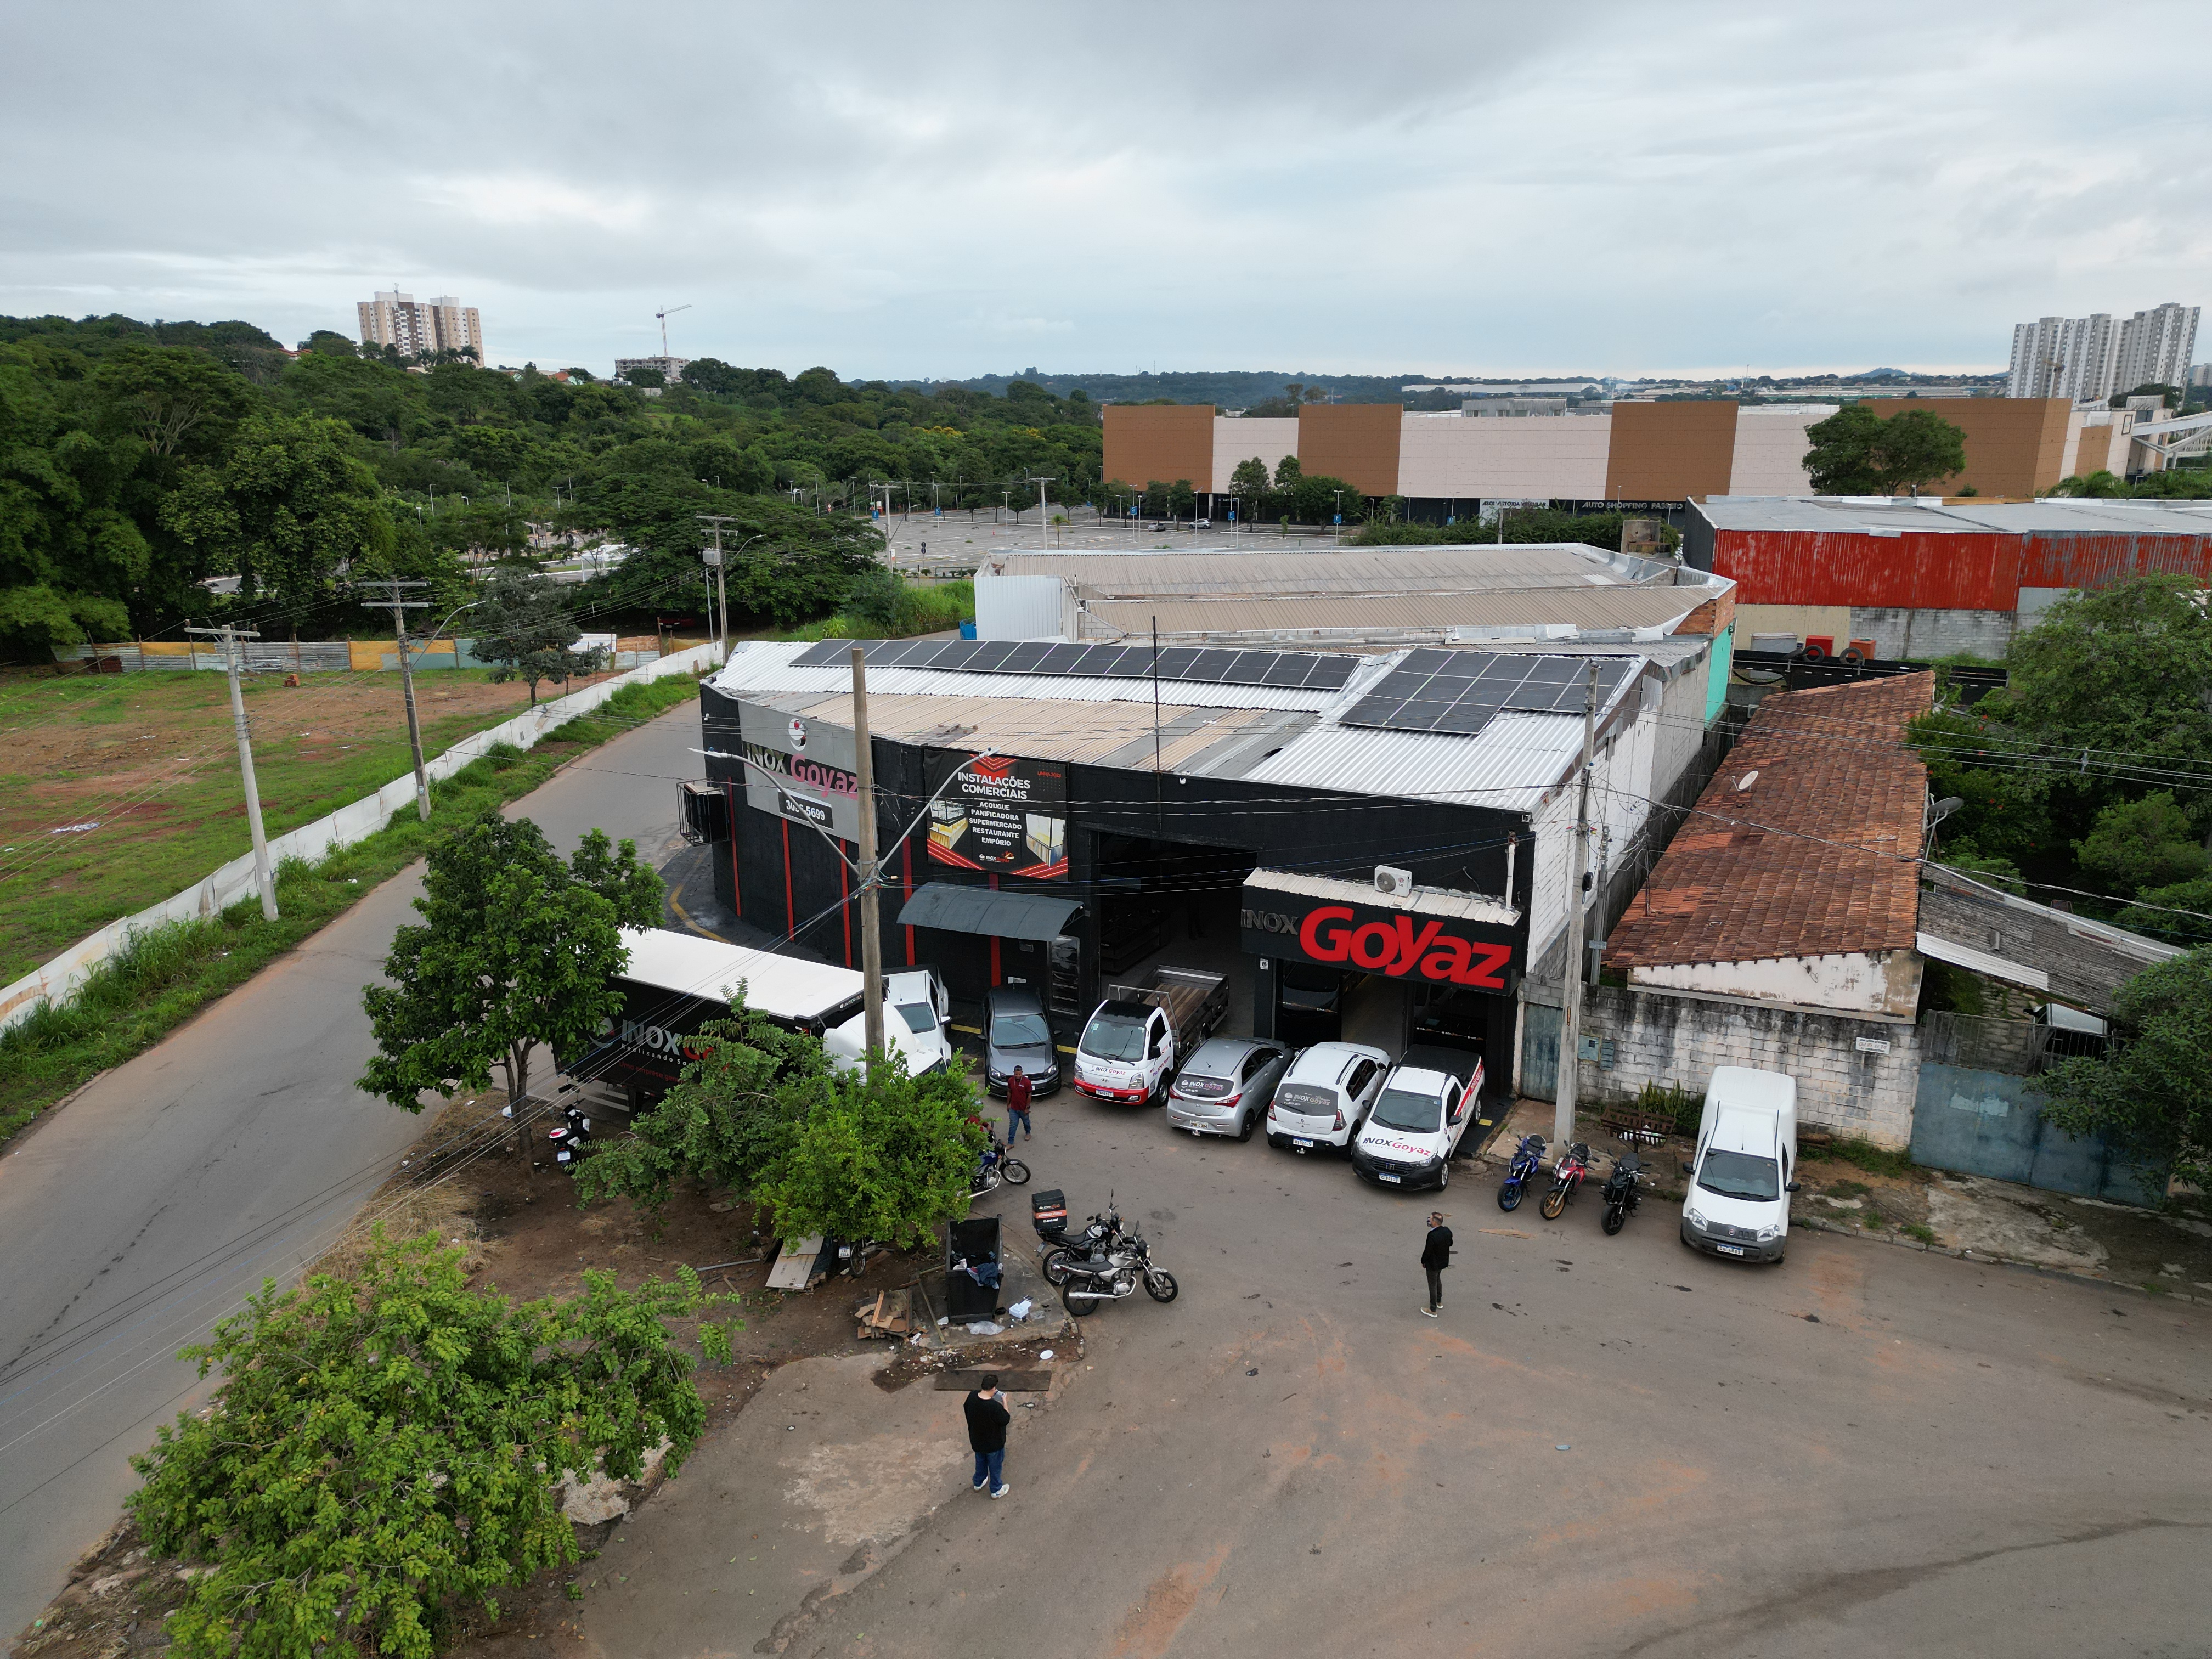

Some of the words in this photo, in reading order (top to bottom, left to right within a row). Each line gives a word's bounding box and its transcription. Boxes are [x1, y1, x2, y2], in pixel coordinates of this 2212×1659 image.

[747, 742, 788, 775] INOX
[958, 771, 1031, 789] INSTALAÇÕES
[962, 783, 1028, 800] COMERCIAIS
[979, 801, 1011, 811] AÇOUGUE
[969, 817, 1022, 830] SUPERMERCADO
[970, 809, 1019, 821] PANIFICADORA
[972, 827, 1019, 839] RESTAURANTE
[981, 837, 1011, 847] EMPÓRIO
[1240, 909, 1299, 935] INOX
[1300, 906, 1512, 990] Goyaz
[622, 1019, 681, 1056] INOX
[1362, 1137, 1393, 1147] INOX
[1392, 1142, 1431, 1156] Goyaz
